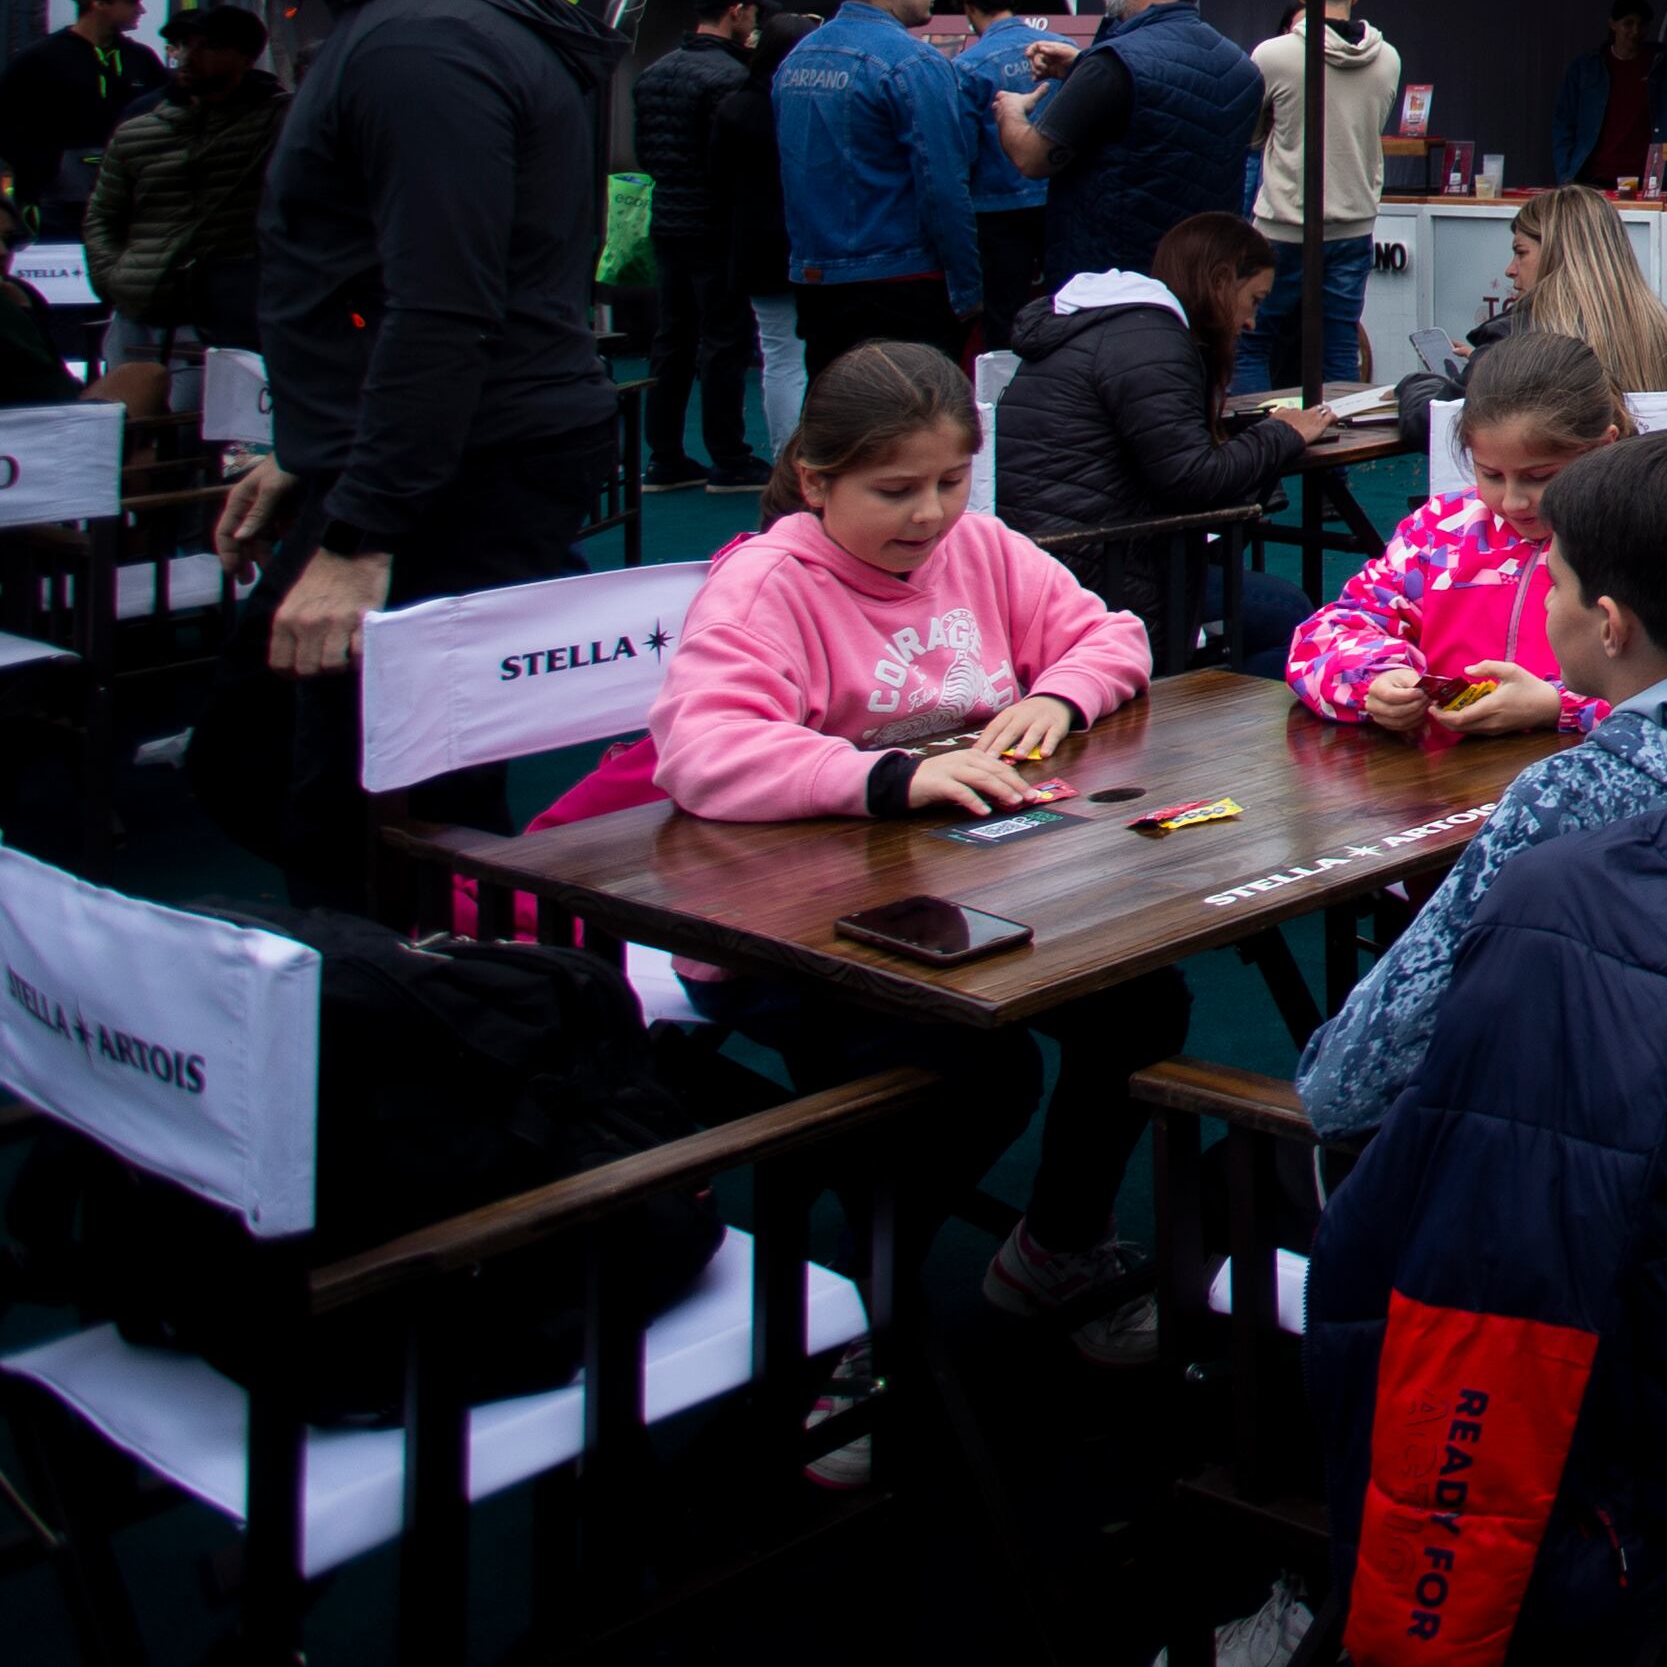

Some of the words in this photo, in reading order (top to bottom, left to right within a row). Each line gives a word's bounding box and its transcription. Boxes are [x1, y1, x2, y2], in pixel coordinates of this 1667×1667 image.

[782, 68, 849, 90] CARPANO
[500, 635, 637, 682] STELLA
[1204, 857, 1353, 907] STELLA
[97, 1022, 206, 1094] ARTOIS
[1430, 1389, 1490, 1535] READY
[1408, 1546, 1455, 1641] FOR
